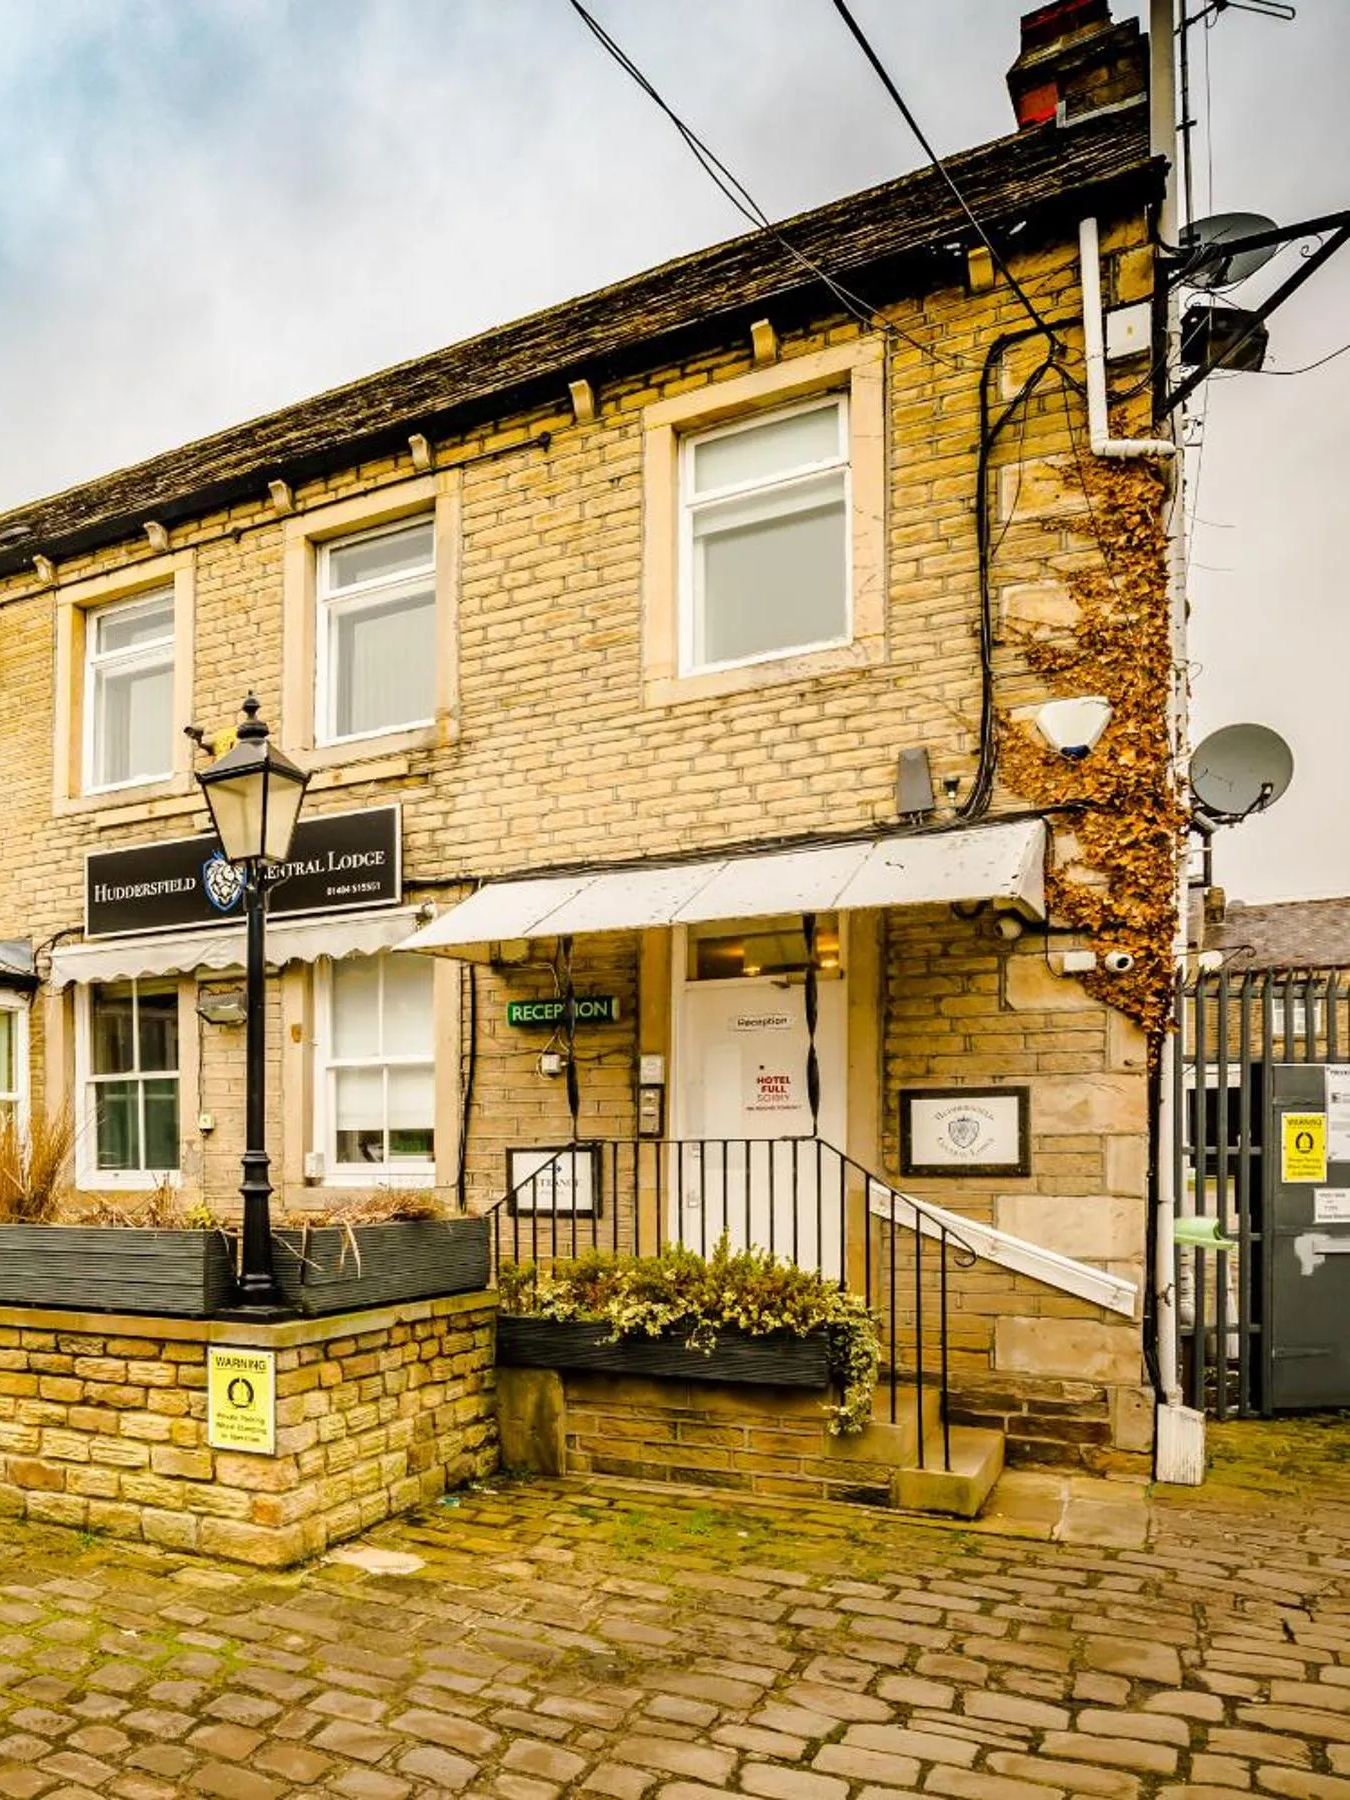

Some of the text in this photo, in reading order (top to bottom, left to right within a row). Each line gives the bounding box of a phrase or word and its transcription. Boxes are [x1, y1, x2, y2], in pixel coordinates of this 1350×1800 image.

[94, 850, 386, 903] HUDDERSFIELD ENTRAL LODGE
[512, 1001, 608, 1022] RECEPION
[737, 1017, 788, 1027] Reception
[756, 1075, 792, 1085] HOTEL
[761, 1085, 788, 1094] FULL
[215, 1356, 267, 1370] WARNING
